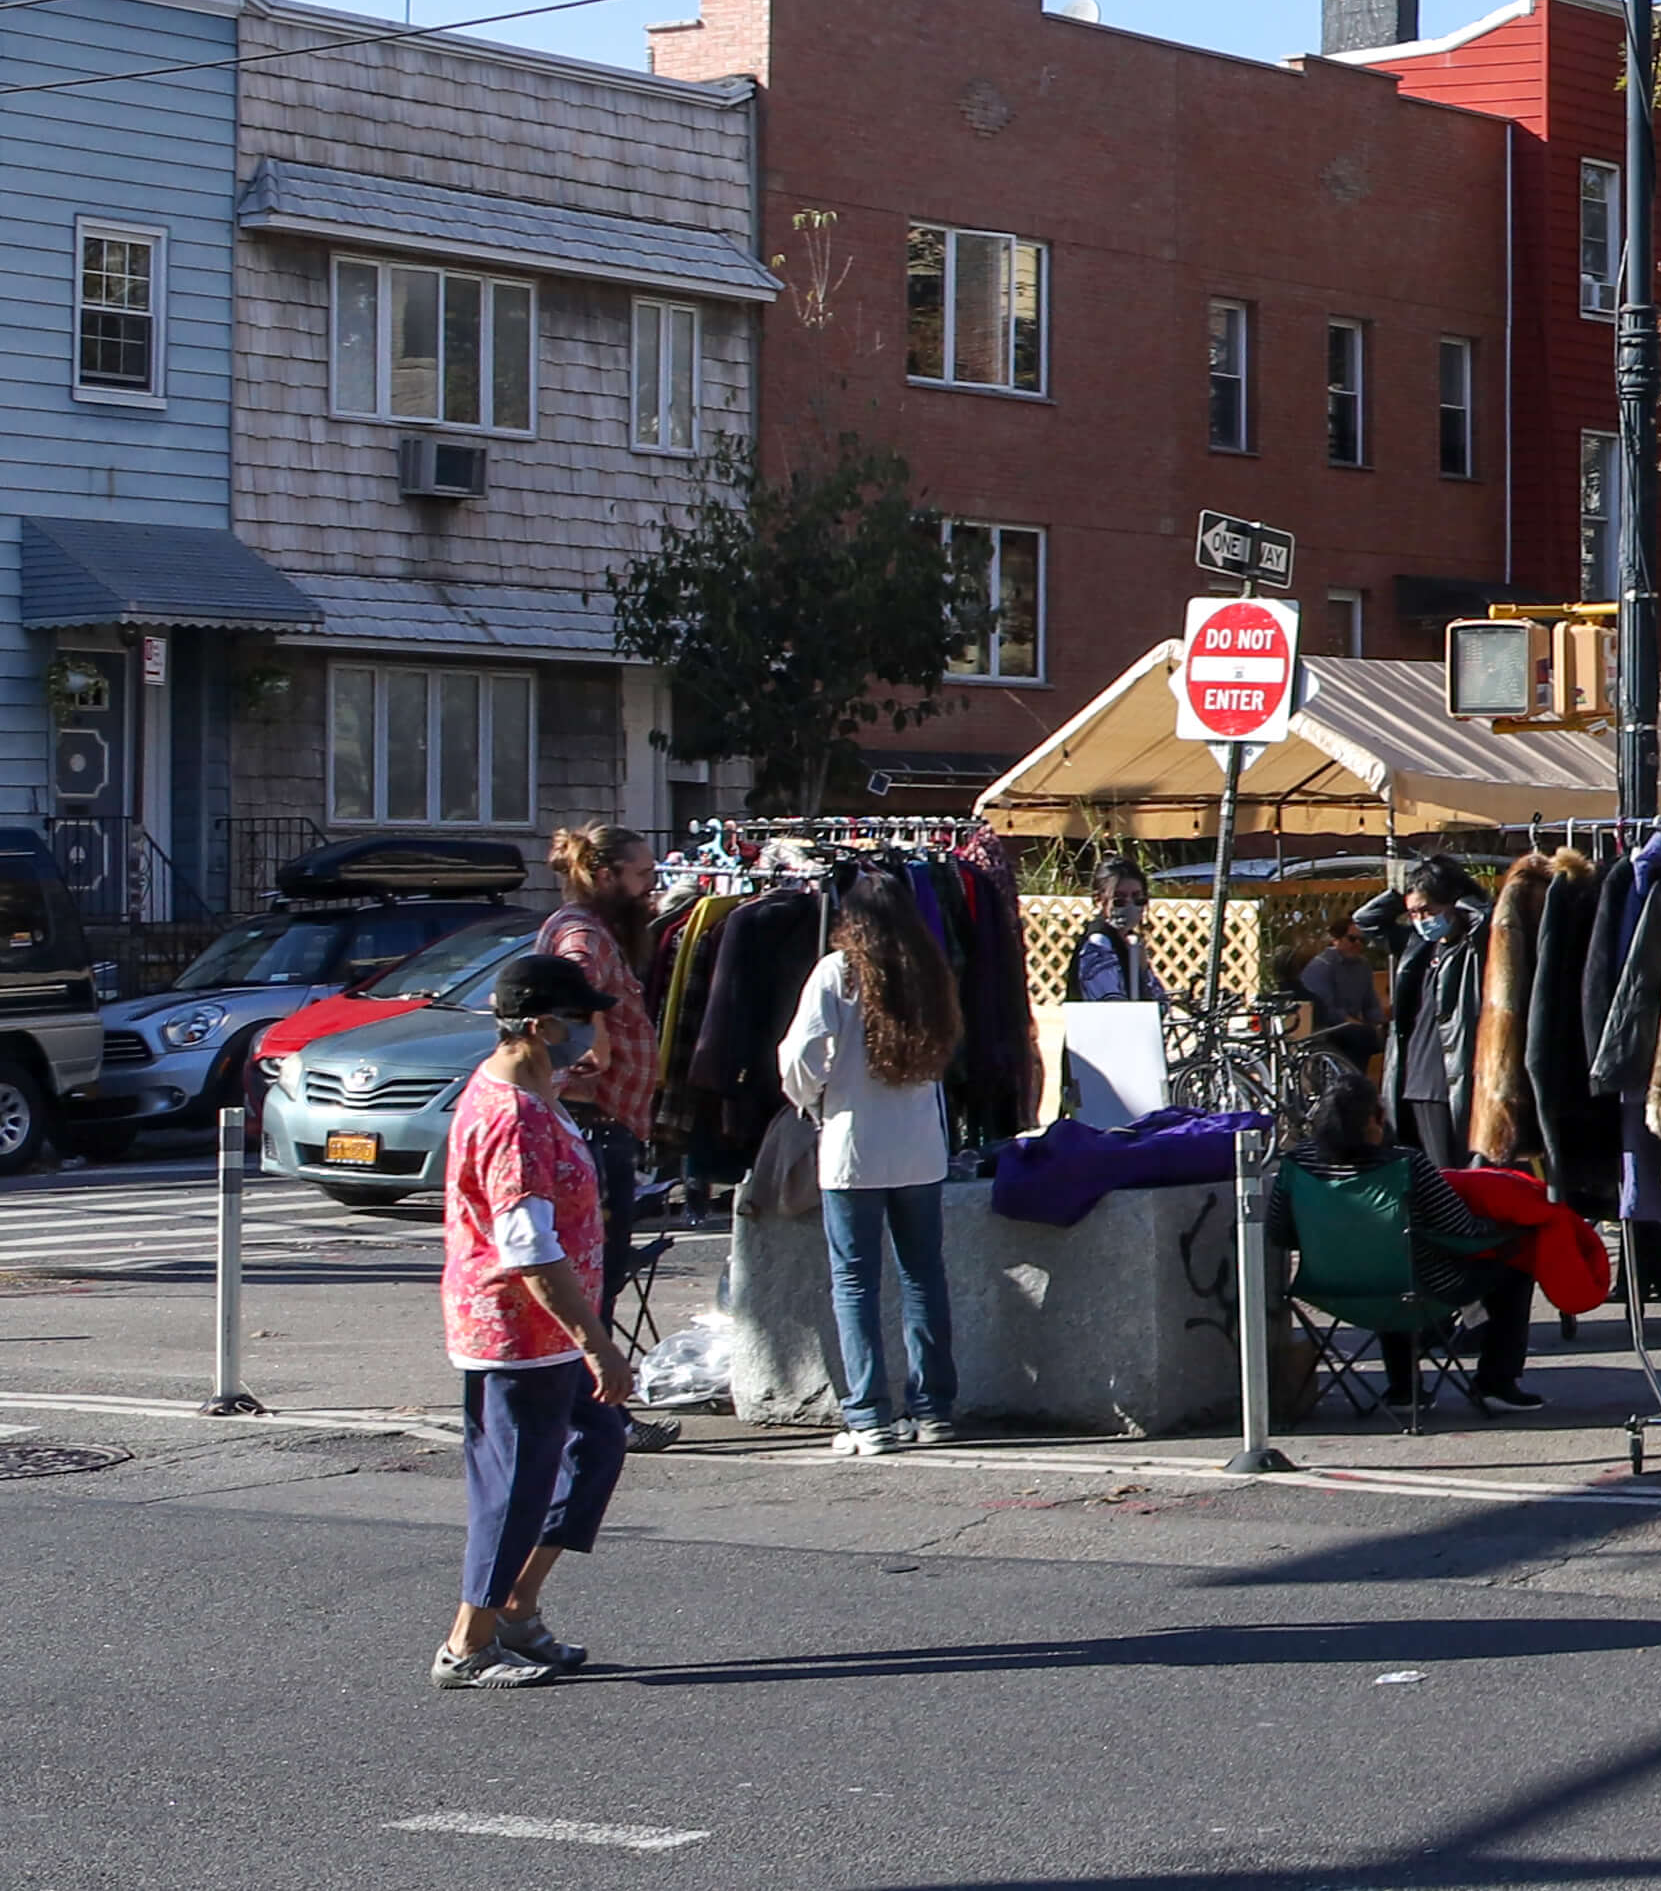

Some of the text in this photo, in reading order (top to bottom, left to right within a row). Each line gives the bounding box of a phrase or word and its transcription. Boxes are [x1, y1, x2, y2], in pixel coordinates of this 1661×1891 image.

[1213, 532, 1241, 558] ONE
[1205, 628, 1277, 651] DO NOT
[1204, 688, 1265, 712] ENTER
